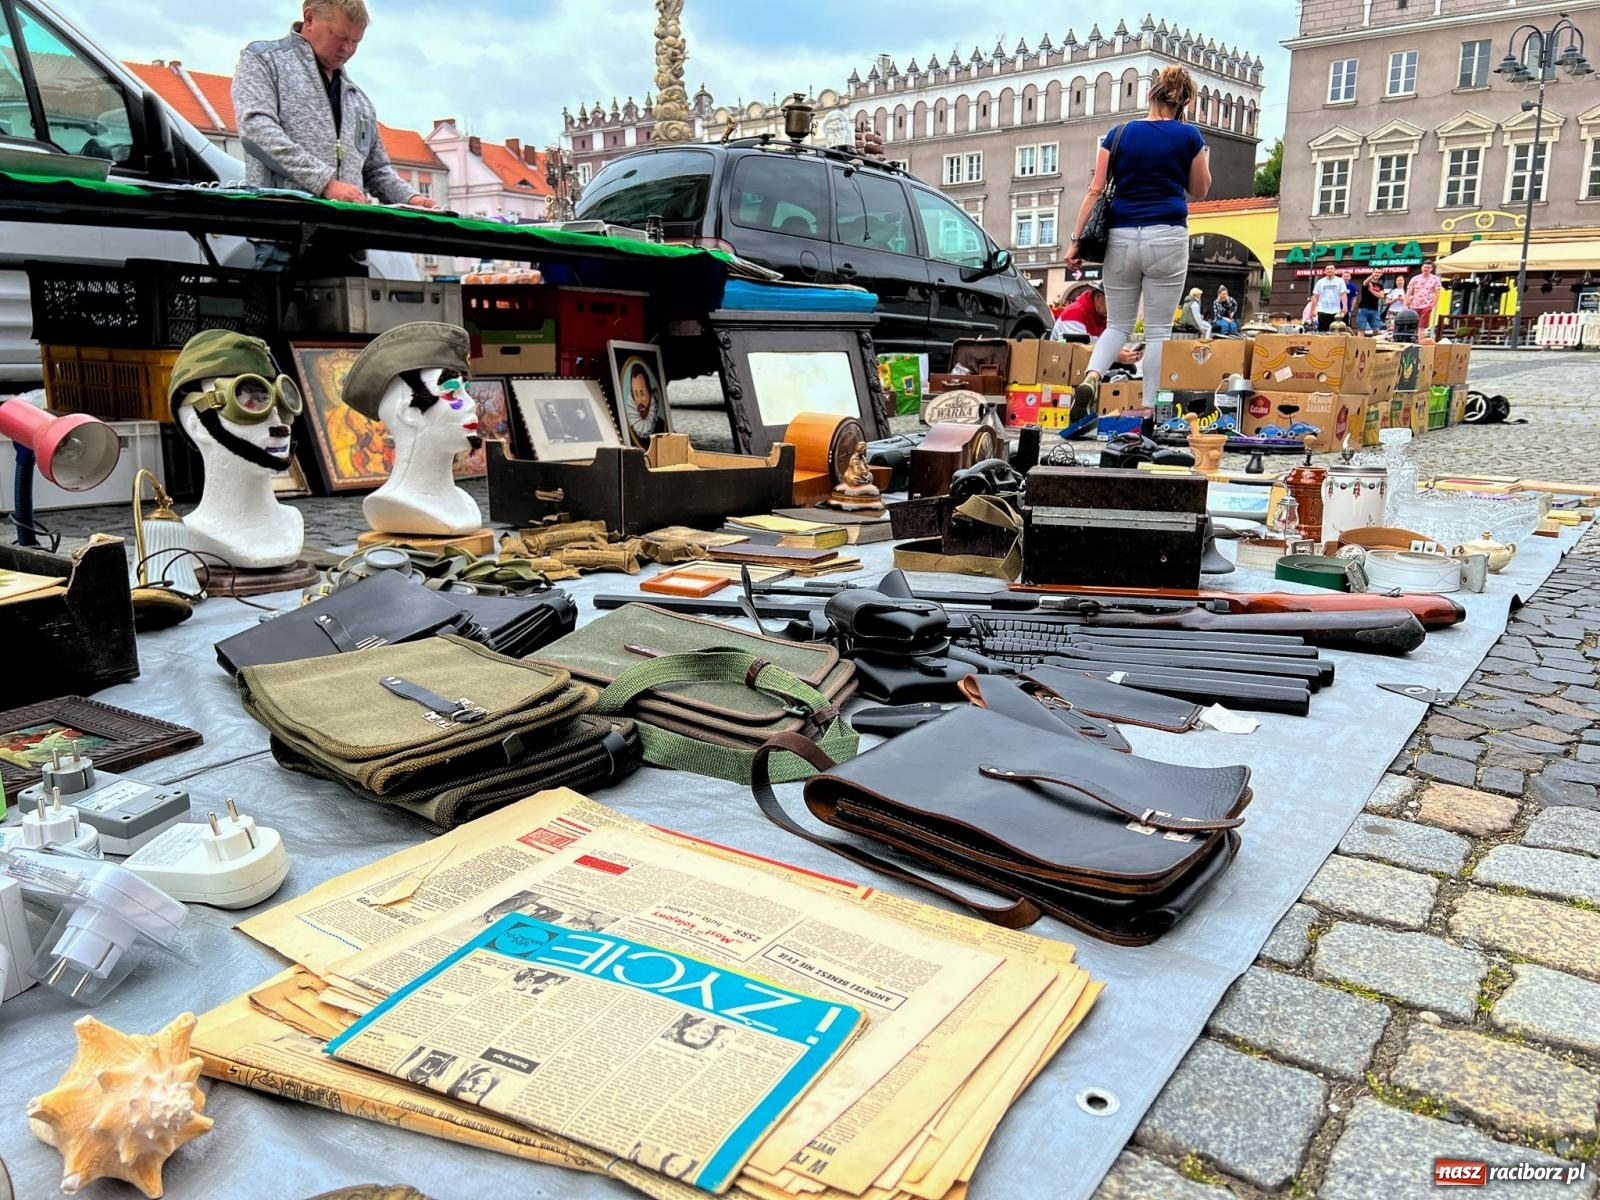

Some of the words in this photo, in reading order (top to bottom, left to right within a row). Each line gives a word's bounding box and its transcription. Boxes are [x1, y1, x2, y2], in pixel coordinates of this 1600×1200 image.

[1285, 240, 1424, 264] APTEKA
[1306, 403, 1332, 413] BANANAS
[1307, 395, 1333, 404] PREMIUM
[937, 407, 973, 418] WARKA
[653, 914, 696, 932] kolejowy
[735, 926, 762, 942] ZSRR
[814, 969, 849, 988] BENESZ
[849, 983, 892, 1003] ANDRZEJ
